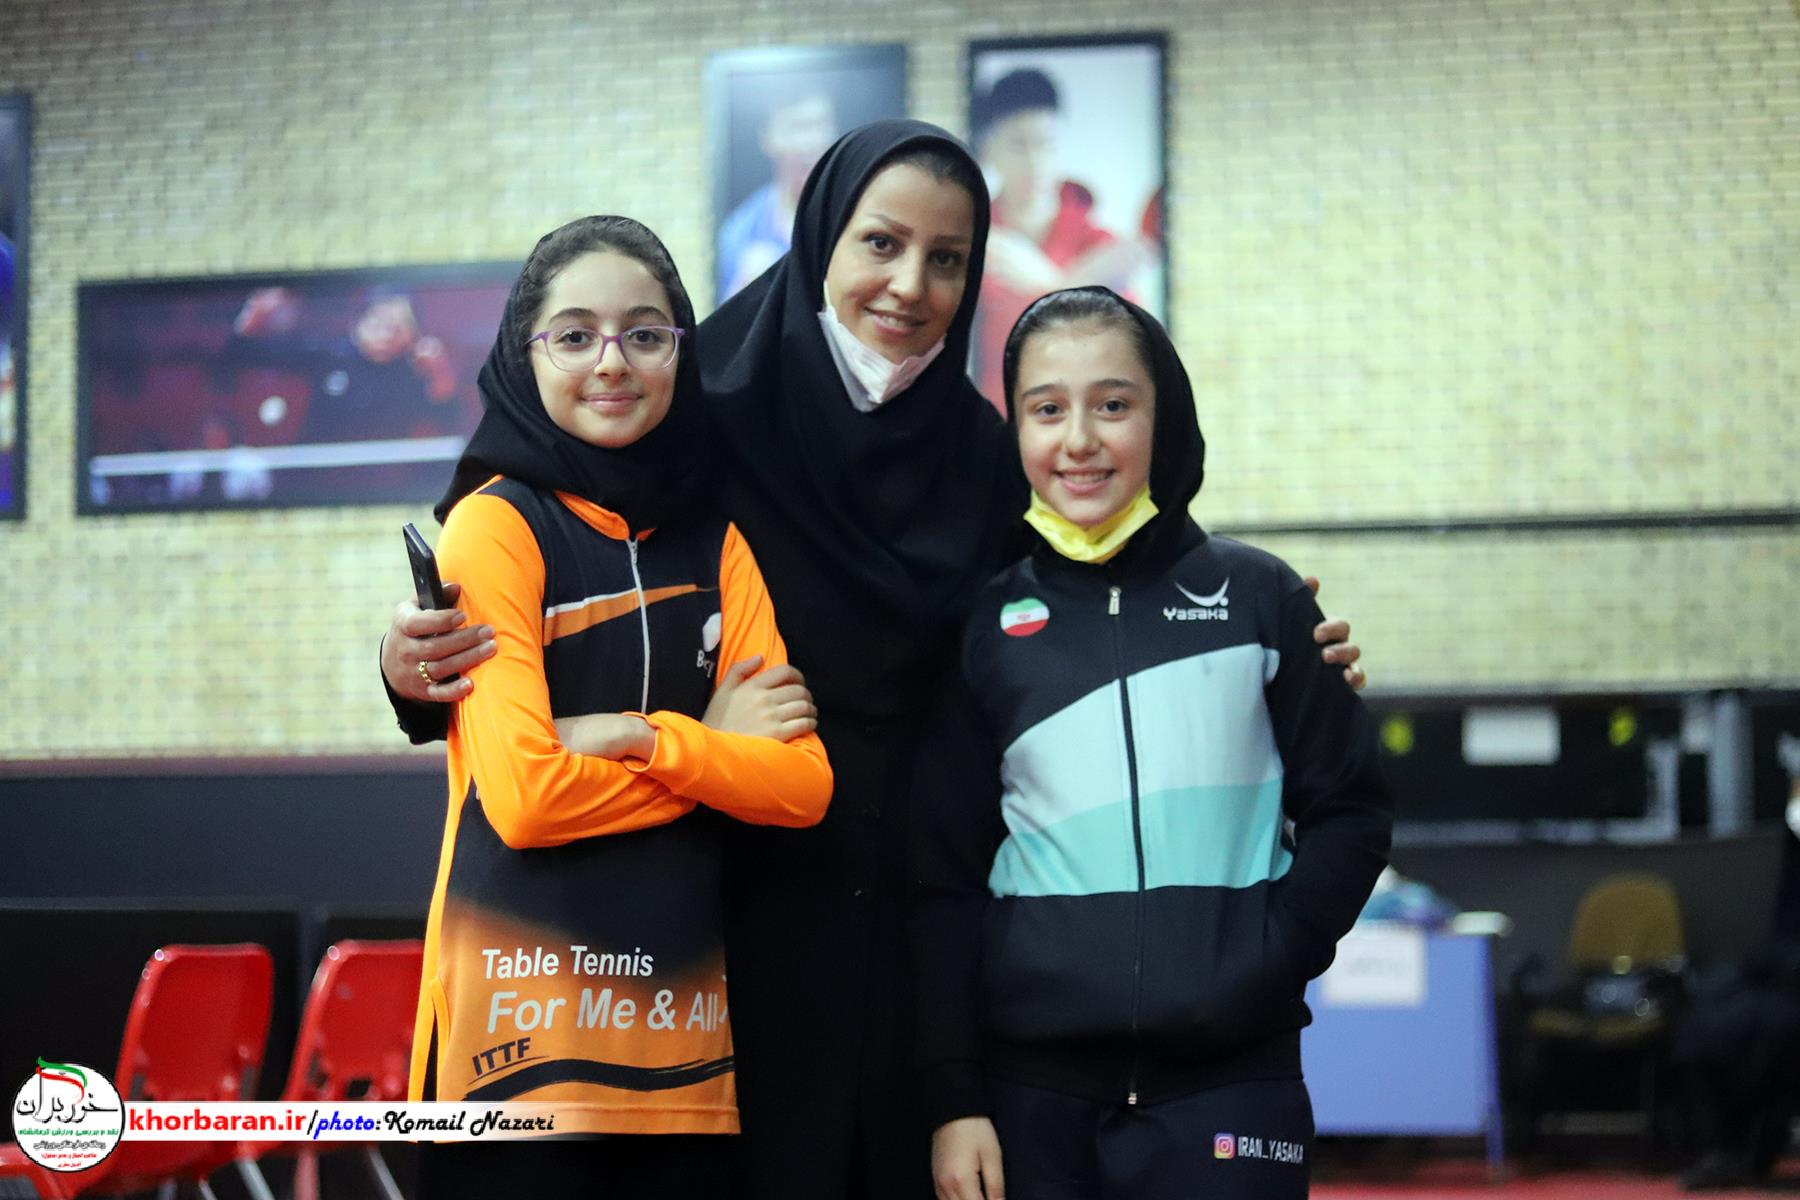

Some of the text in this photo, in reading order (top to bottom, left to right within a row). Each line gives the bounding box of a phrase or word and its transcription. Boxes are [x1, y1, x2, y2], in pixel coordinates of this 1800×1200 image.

[482, 945, 654, 979] Table Tennis
[487, 991, 567, 1034] For
[576, 988, 636, 1030] Me
[647, 989, 676, 1030] &
[471, 1037, 531, 1076] ITTF
